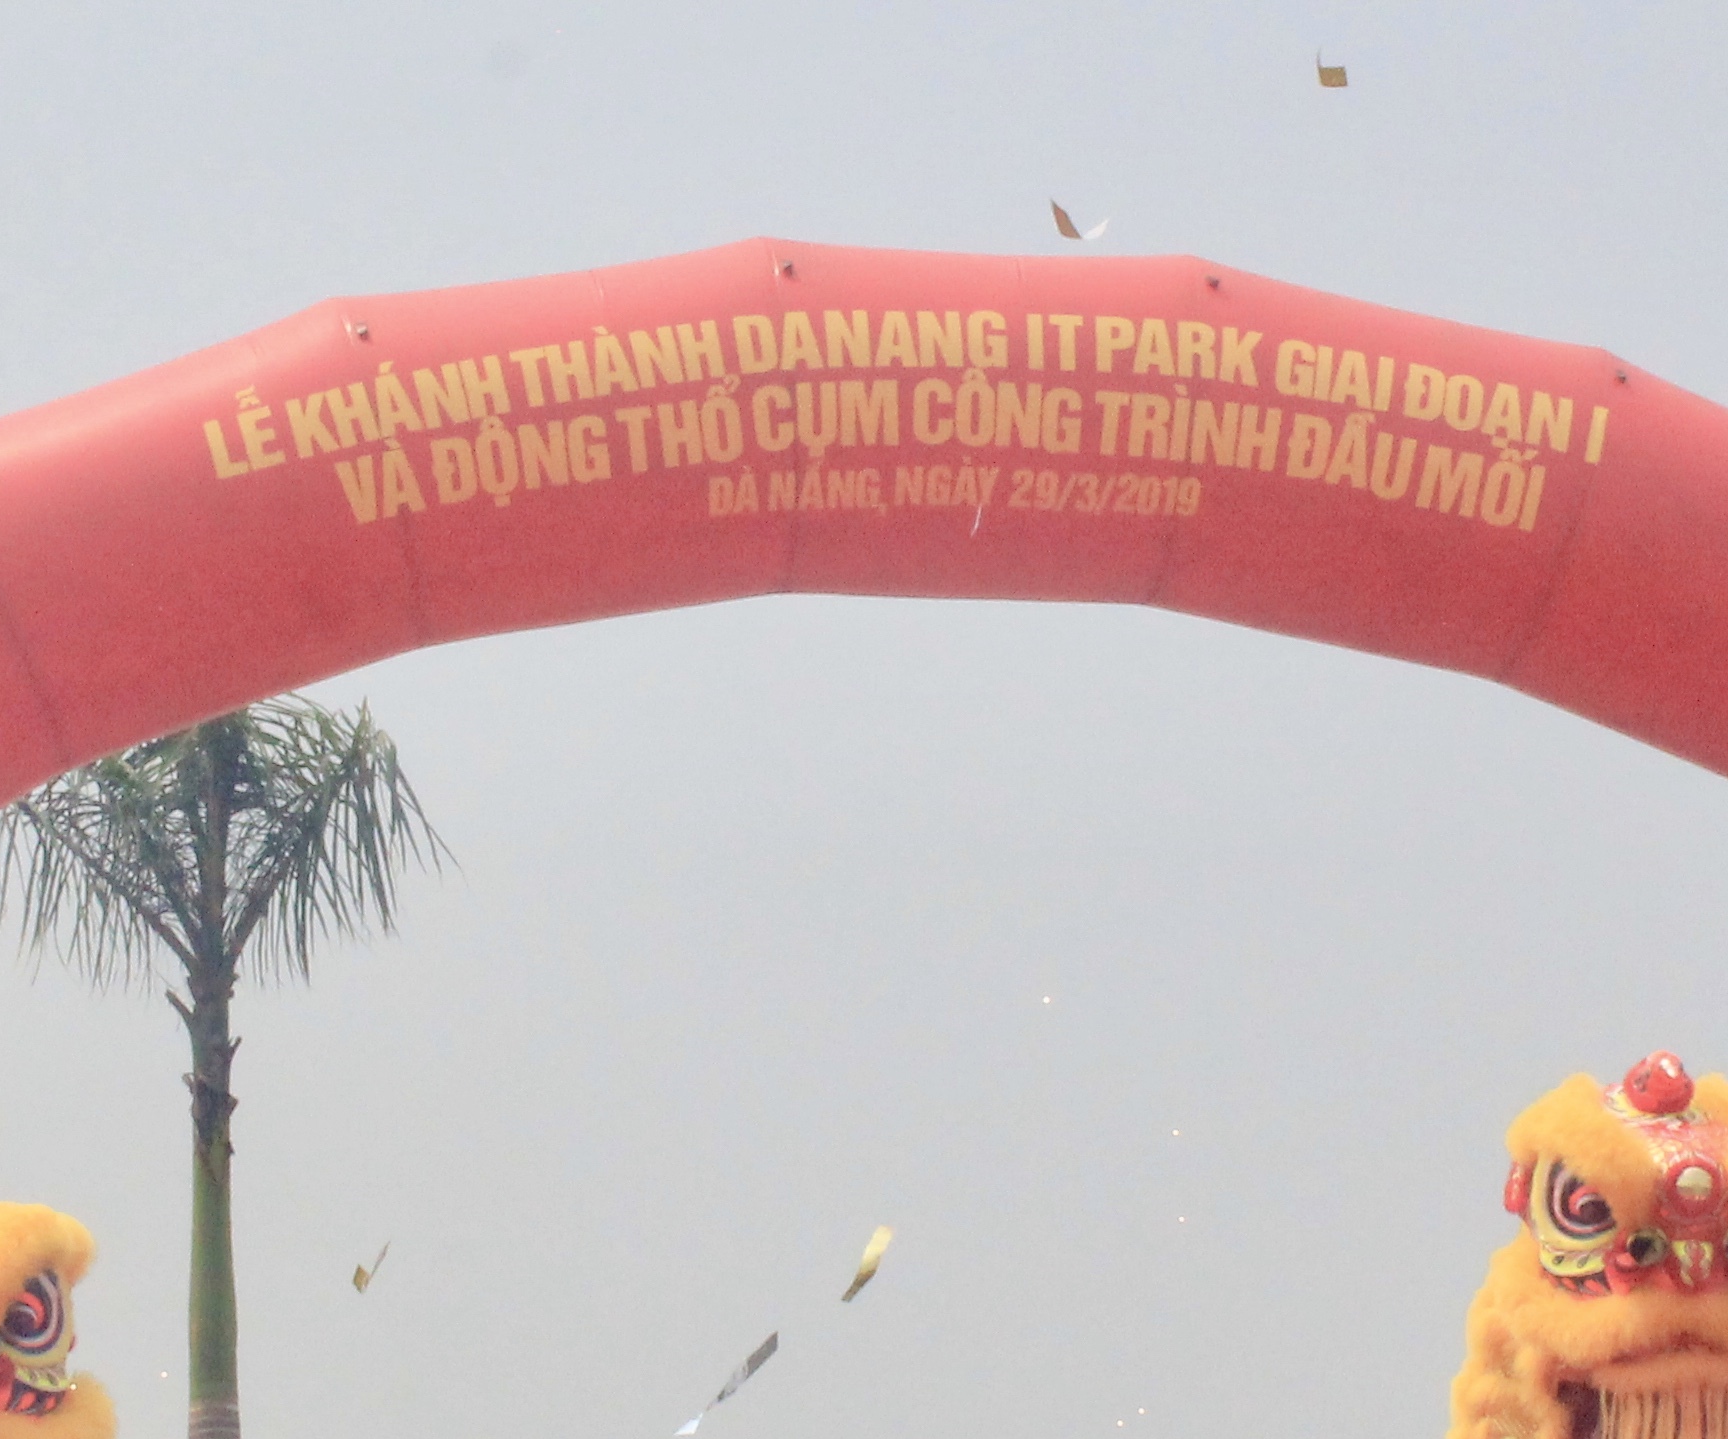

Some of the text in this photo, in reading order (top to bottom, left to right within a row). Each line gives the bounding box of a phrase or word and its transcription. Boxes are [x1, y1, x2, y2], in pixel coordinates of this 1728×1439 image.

[203, 384, 286, 480] LỄ
[285, 354, 513, 460] KHÁNH
[508, 318, 725, 407] THÀNH
[731, 309, 1009, 373] DANANG
[1026, 312, 1084, 373] IT
[1095, 314, 1264, 388] PARK
[1275, 338, 1396, 413] GIAI
[1402, 362, 1574, 454] ĐOẠN
[334, 368, 1546, 533] VÀ ĐỘNG THỔ CỤM CÔNG TRÌNH ĐẦU MỐI
[708, 464, 760, 518] ĐÀ
[894, 455, 1001, 509] NGÀY
[1007, 465, 1203, 517] 29/3/2019
